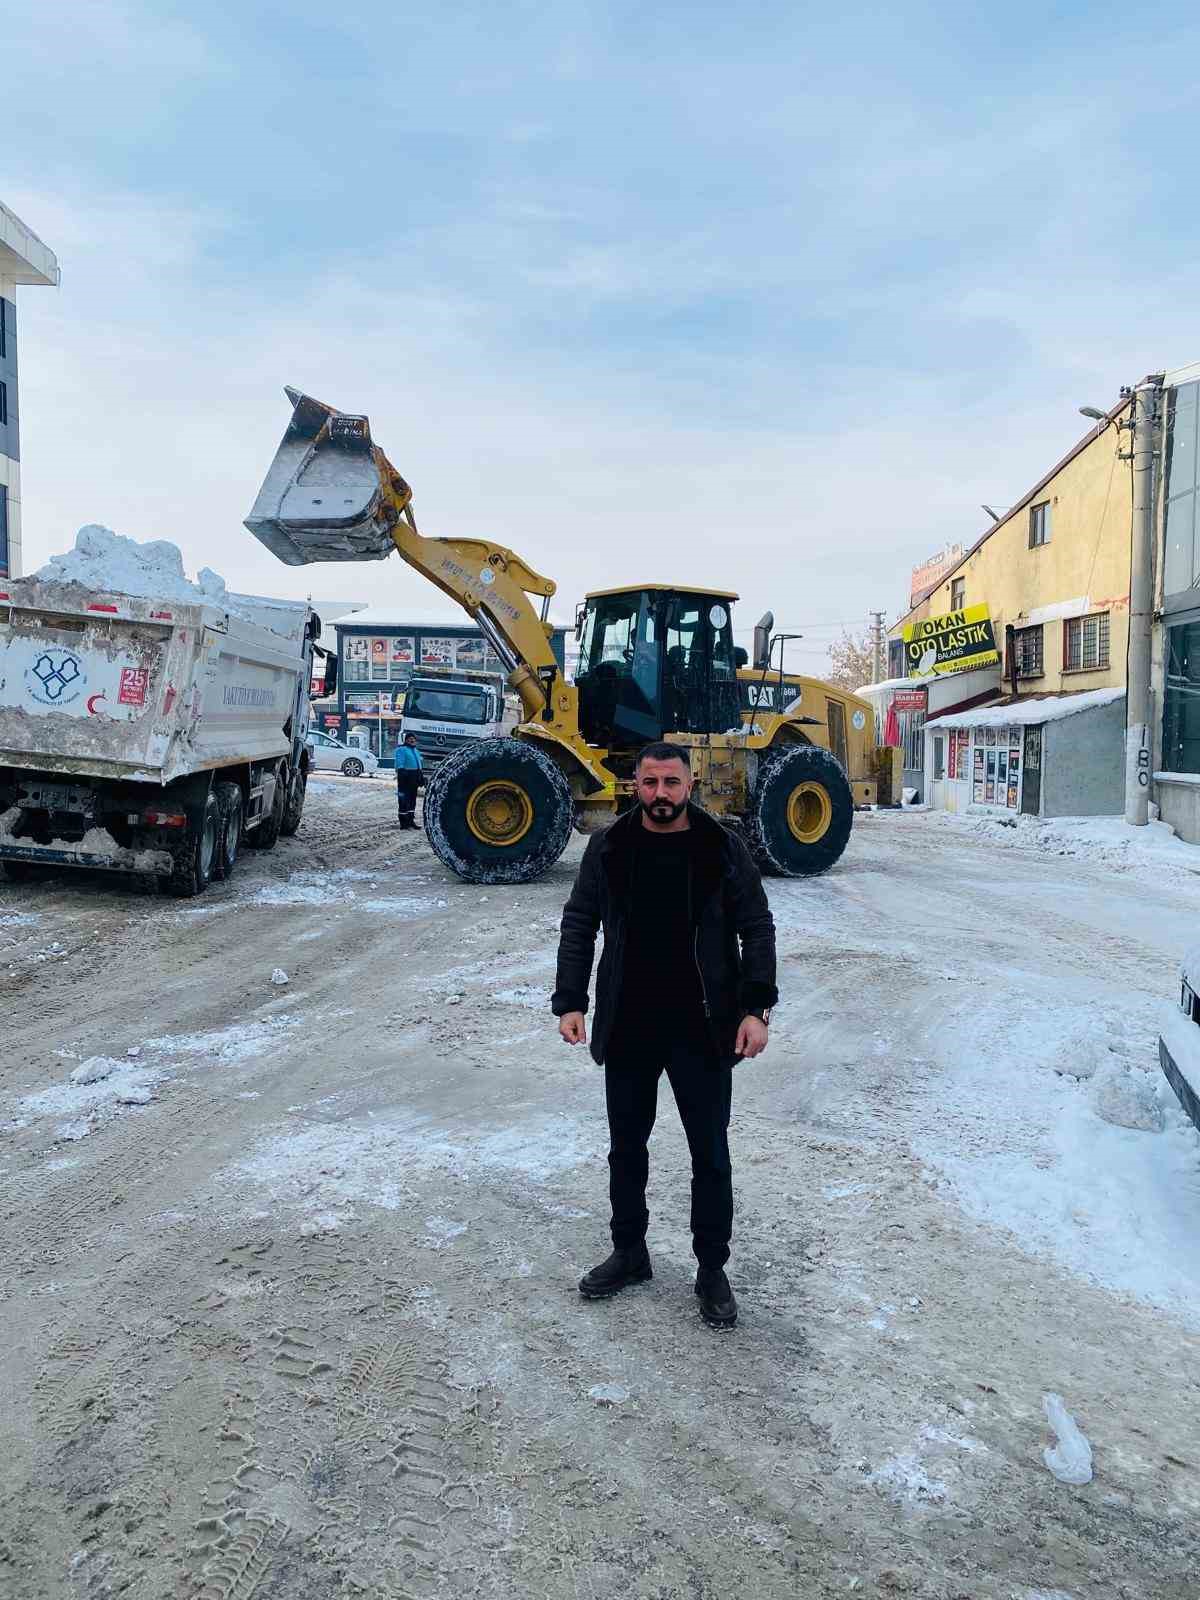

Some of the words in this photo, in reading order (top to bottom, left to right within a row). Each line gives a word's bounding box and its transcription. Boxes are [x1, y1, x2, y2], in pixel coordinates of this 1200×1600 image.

[923, 611, 967, 635] OKAN
[909, 636, 937, 660] OTO
[123, 669, 145, 687] 25
[747, 685, 775, 707] CAT
